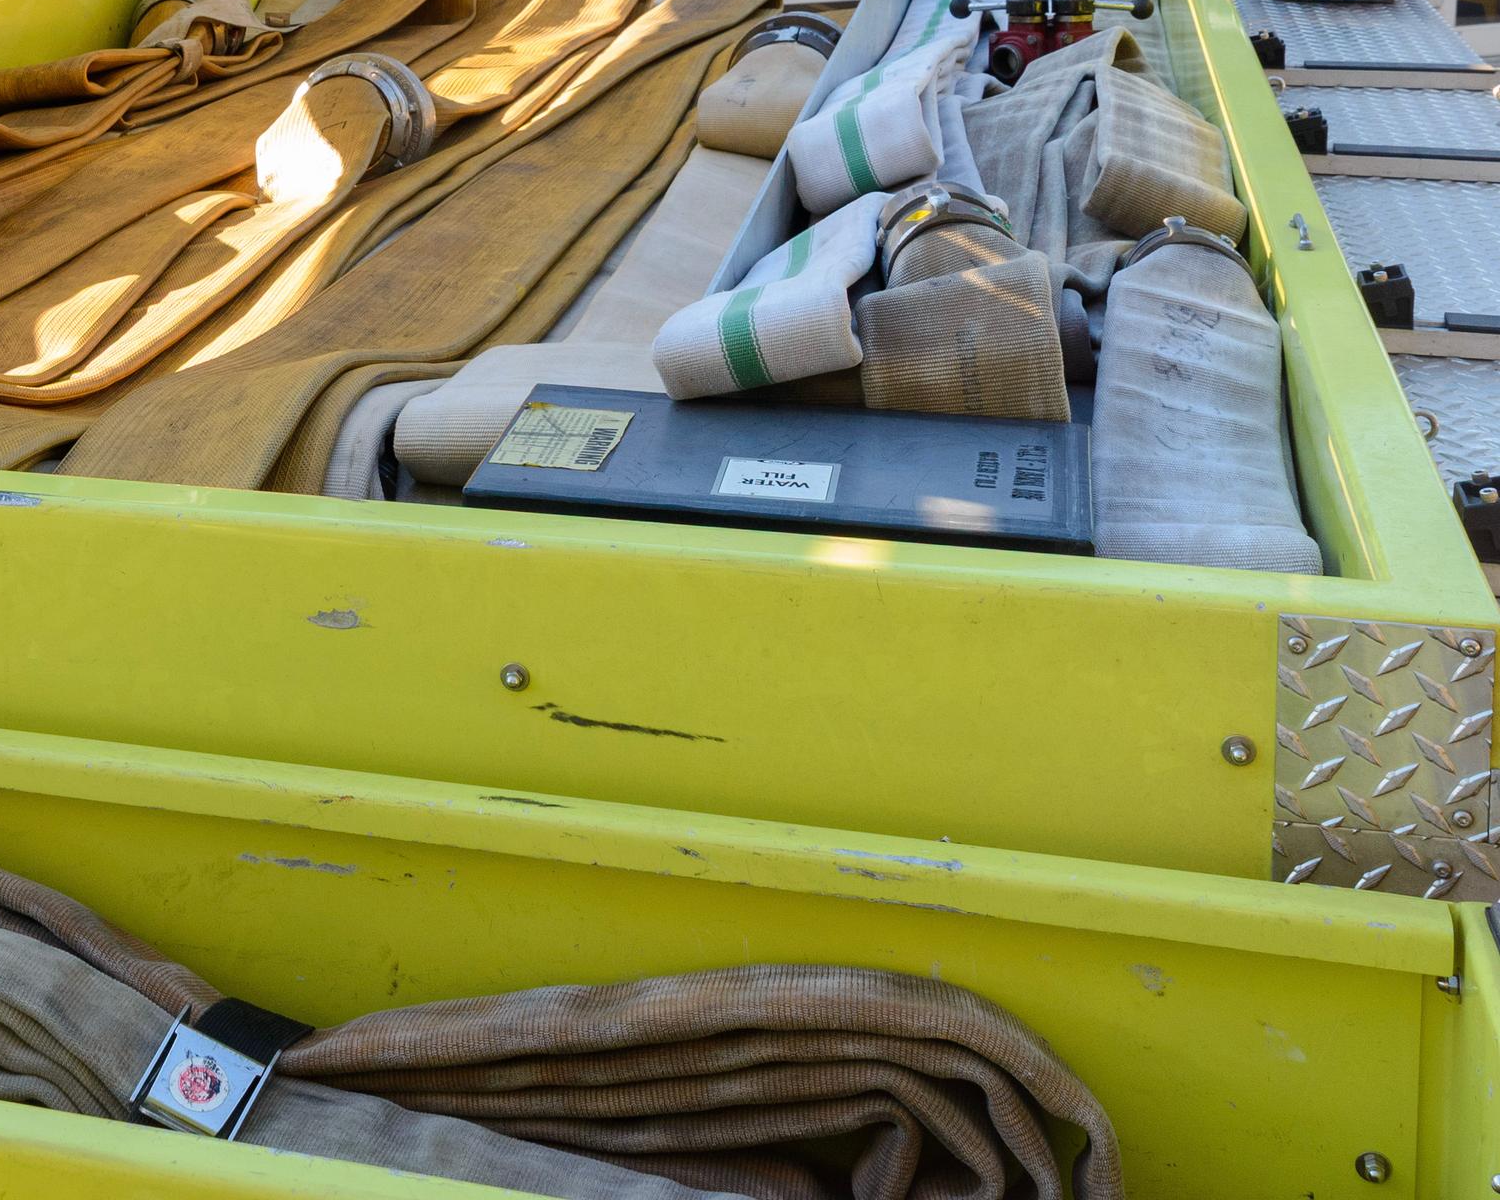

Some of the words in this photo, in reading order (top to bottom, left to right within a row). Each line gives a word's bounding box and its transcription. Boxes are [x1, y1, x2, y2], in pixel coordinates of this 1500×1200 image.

[574, 427, 619, 466] WARNING
[741, 475, 810, 489] WATER
[759, 470, 796, 480] FILL
